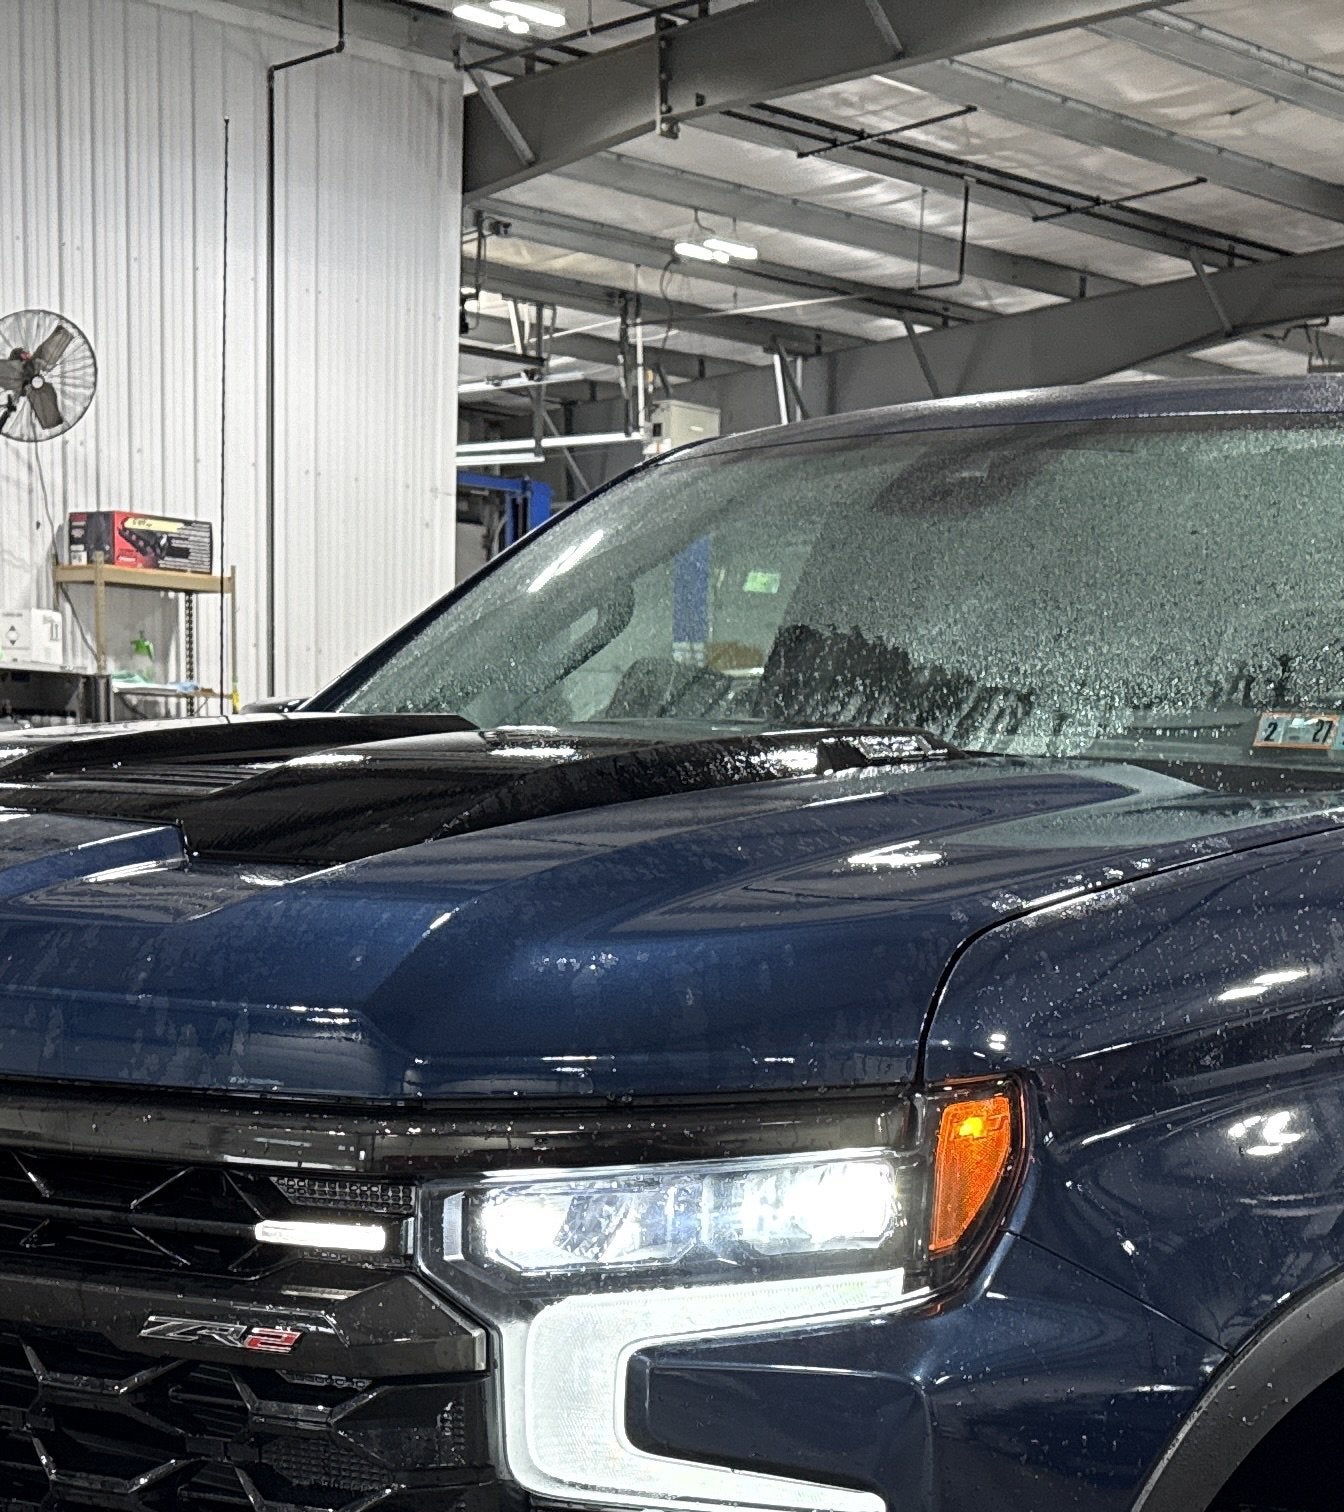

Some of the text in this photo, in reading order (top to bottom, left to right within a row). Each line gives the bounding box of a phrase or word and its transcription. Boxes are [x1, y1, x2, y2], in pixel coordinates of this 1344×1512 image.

[1264, 719, 1334, 744] 2 27
[138, 1315, 304, 1354] ZR2
